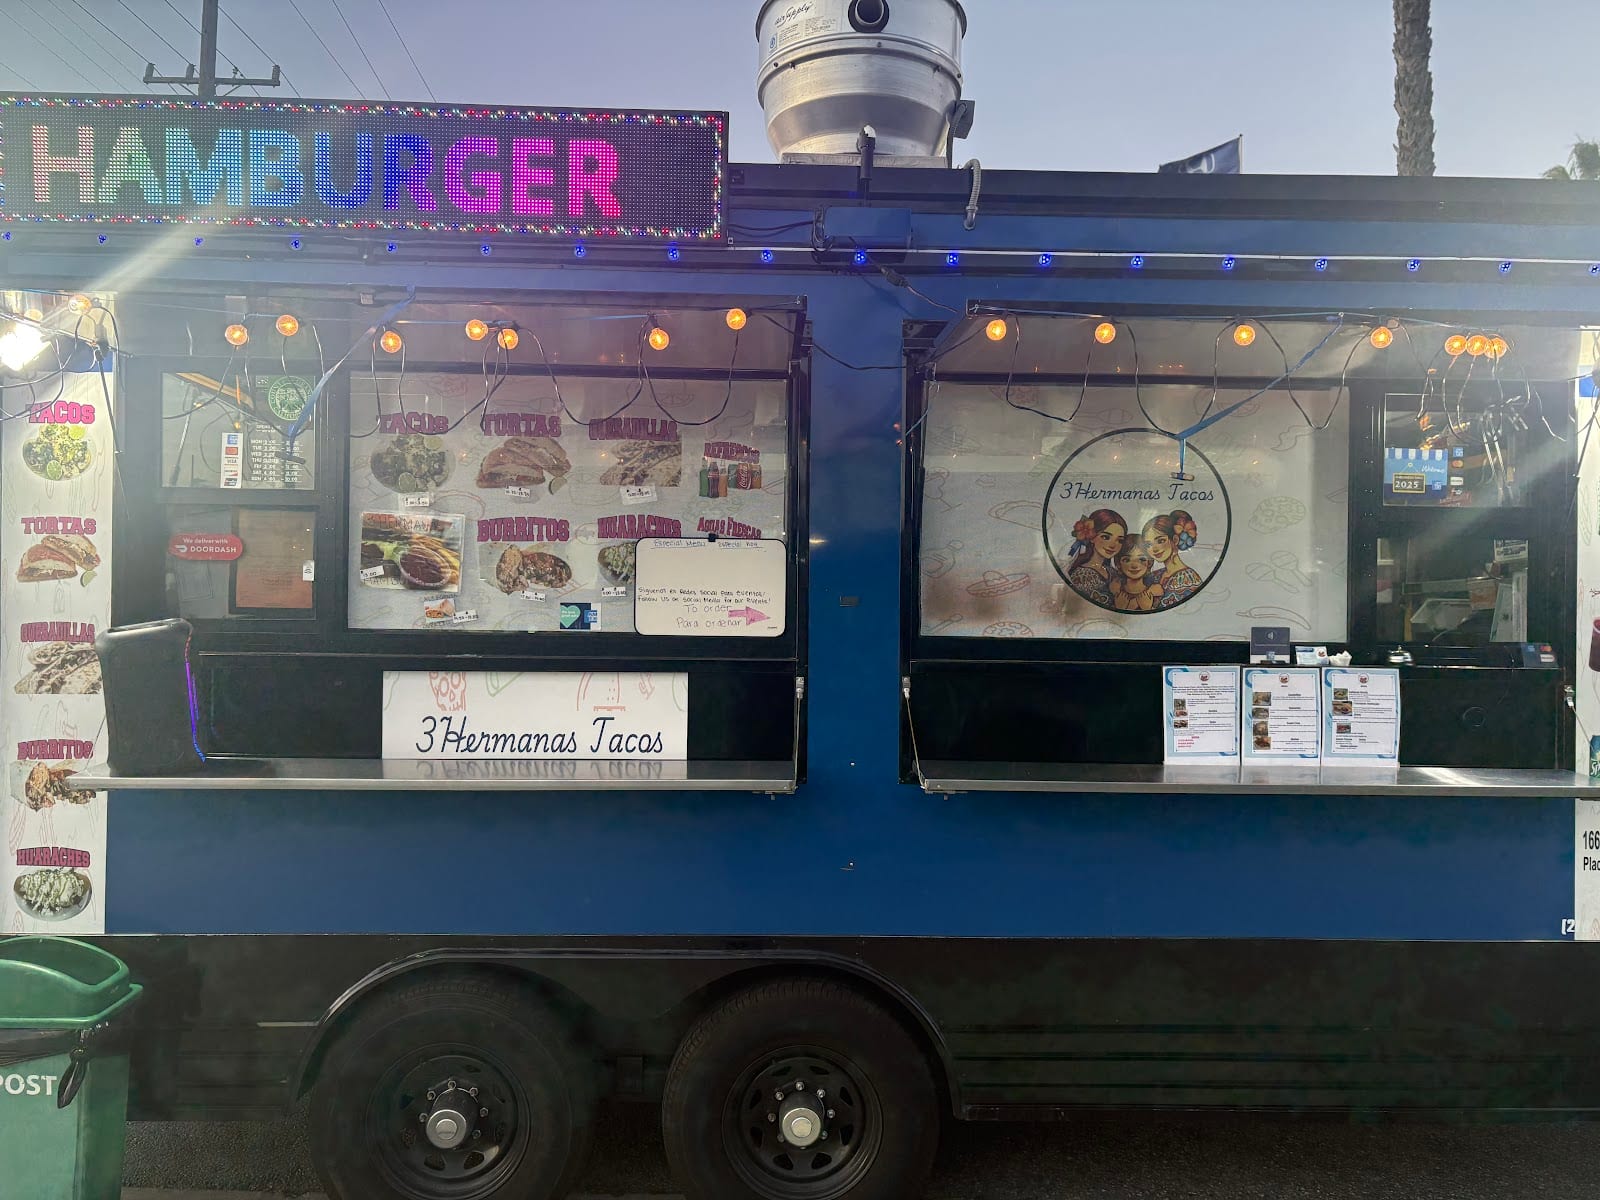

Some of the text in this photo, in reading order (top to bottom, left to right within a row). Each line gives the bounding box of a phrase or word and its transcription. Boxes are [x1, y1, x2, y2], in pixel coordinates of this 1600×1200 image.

[32, 125, 621, 217] HAMBURGER
[25, 400, 95, 424] TACOS
[376, 411, 449, 435] TACOS
[483, 412, 562, 438] TORTAS
[1168, 483, 1214, 501] Tacos
[1395, 481, 1419, 489] 2025
[21, 516, 97, 535] TORTAS
[477, 516, 570, 542] BURRITOS
[597, 514, 682, 539] HUARACHES
[190, 545, 237, 553] DOORDASH
[683, 603, 733, 614] To order
[677, 617, 699, 629] Para
[590, 717, 664, 753] Tacos
[17, 738, 94, 760] BURRITOS
[16, 846, 91, 868] HUARACHES
